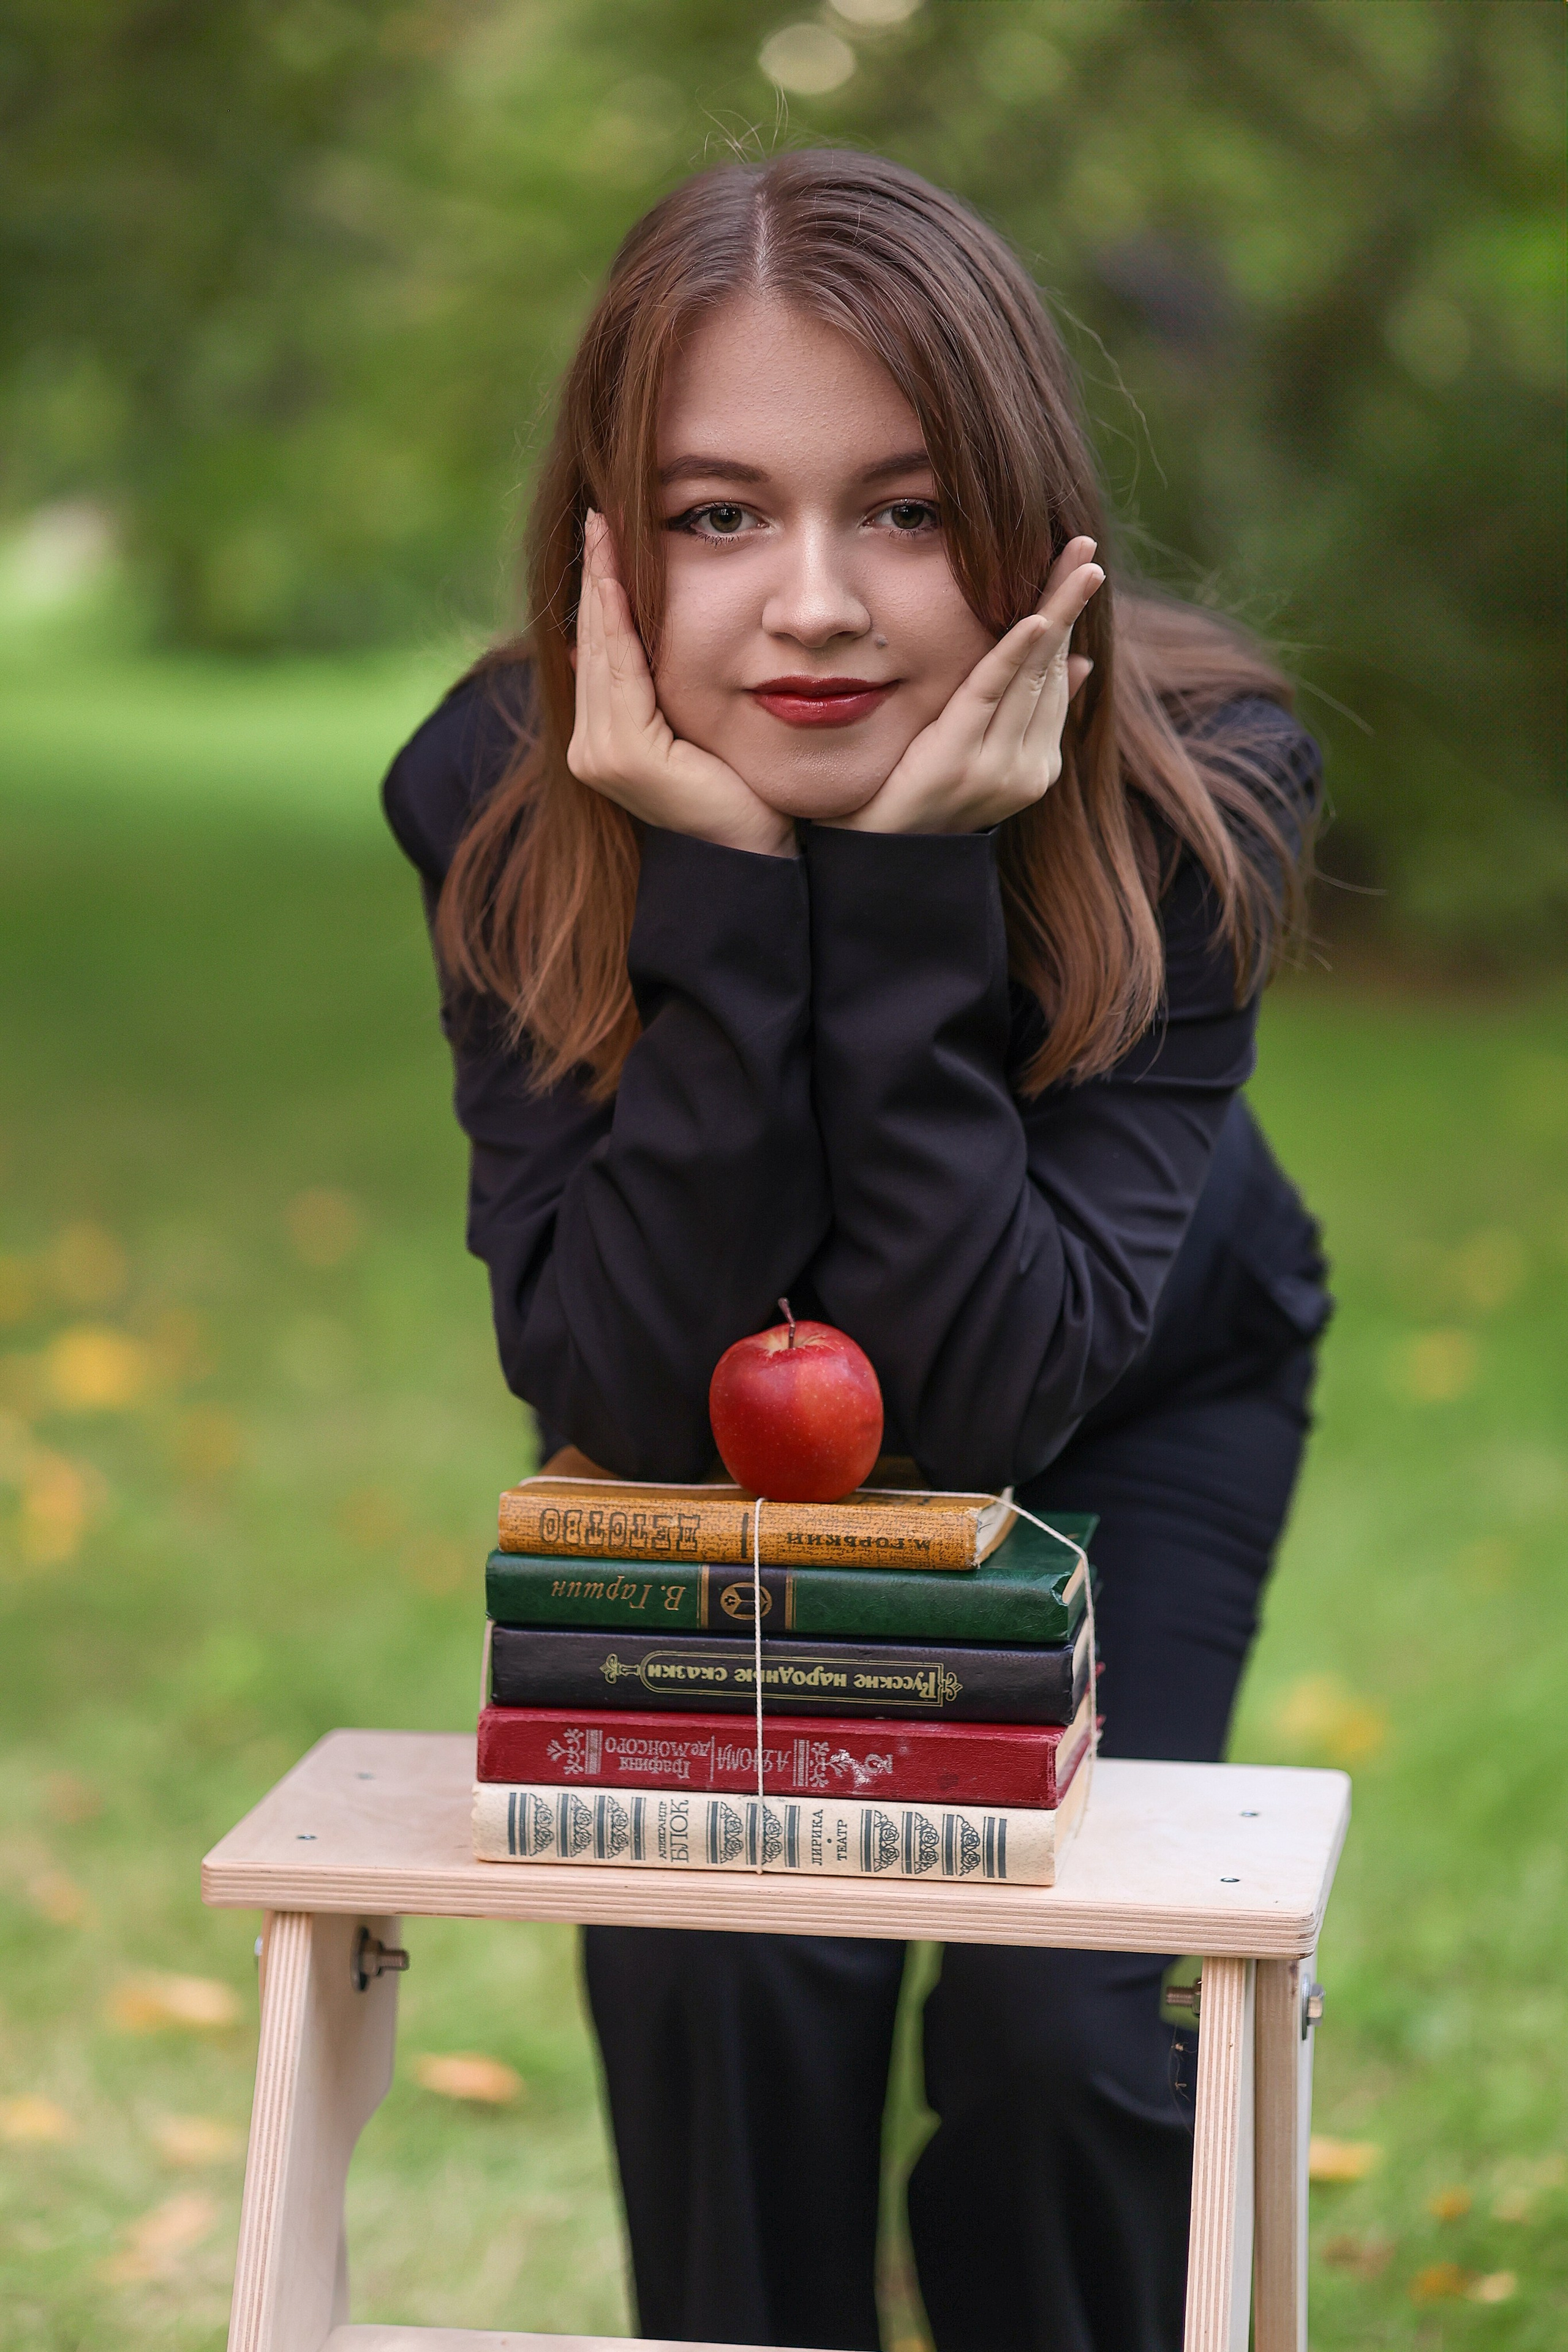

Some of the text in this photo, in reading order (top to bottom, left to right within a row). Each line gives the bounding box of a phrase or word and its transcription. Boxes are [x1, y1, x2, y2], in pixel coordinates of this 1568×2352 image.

[540, 1508, 701, 1551] ДЕТСТВО
[551, 1574, 686, 1611] В. Гаршин
[647, 1664, 937, 1699] Русские народные сказки
[619, 1756, 691, 1780] Графиня
[670, 1800, 690, 1863] БЛОК
[812, 1809, 824, 1866] ЛИРИКА
[837, 1819, 848, 1861] ТЕАТР
